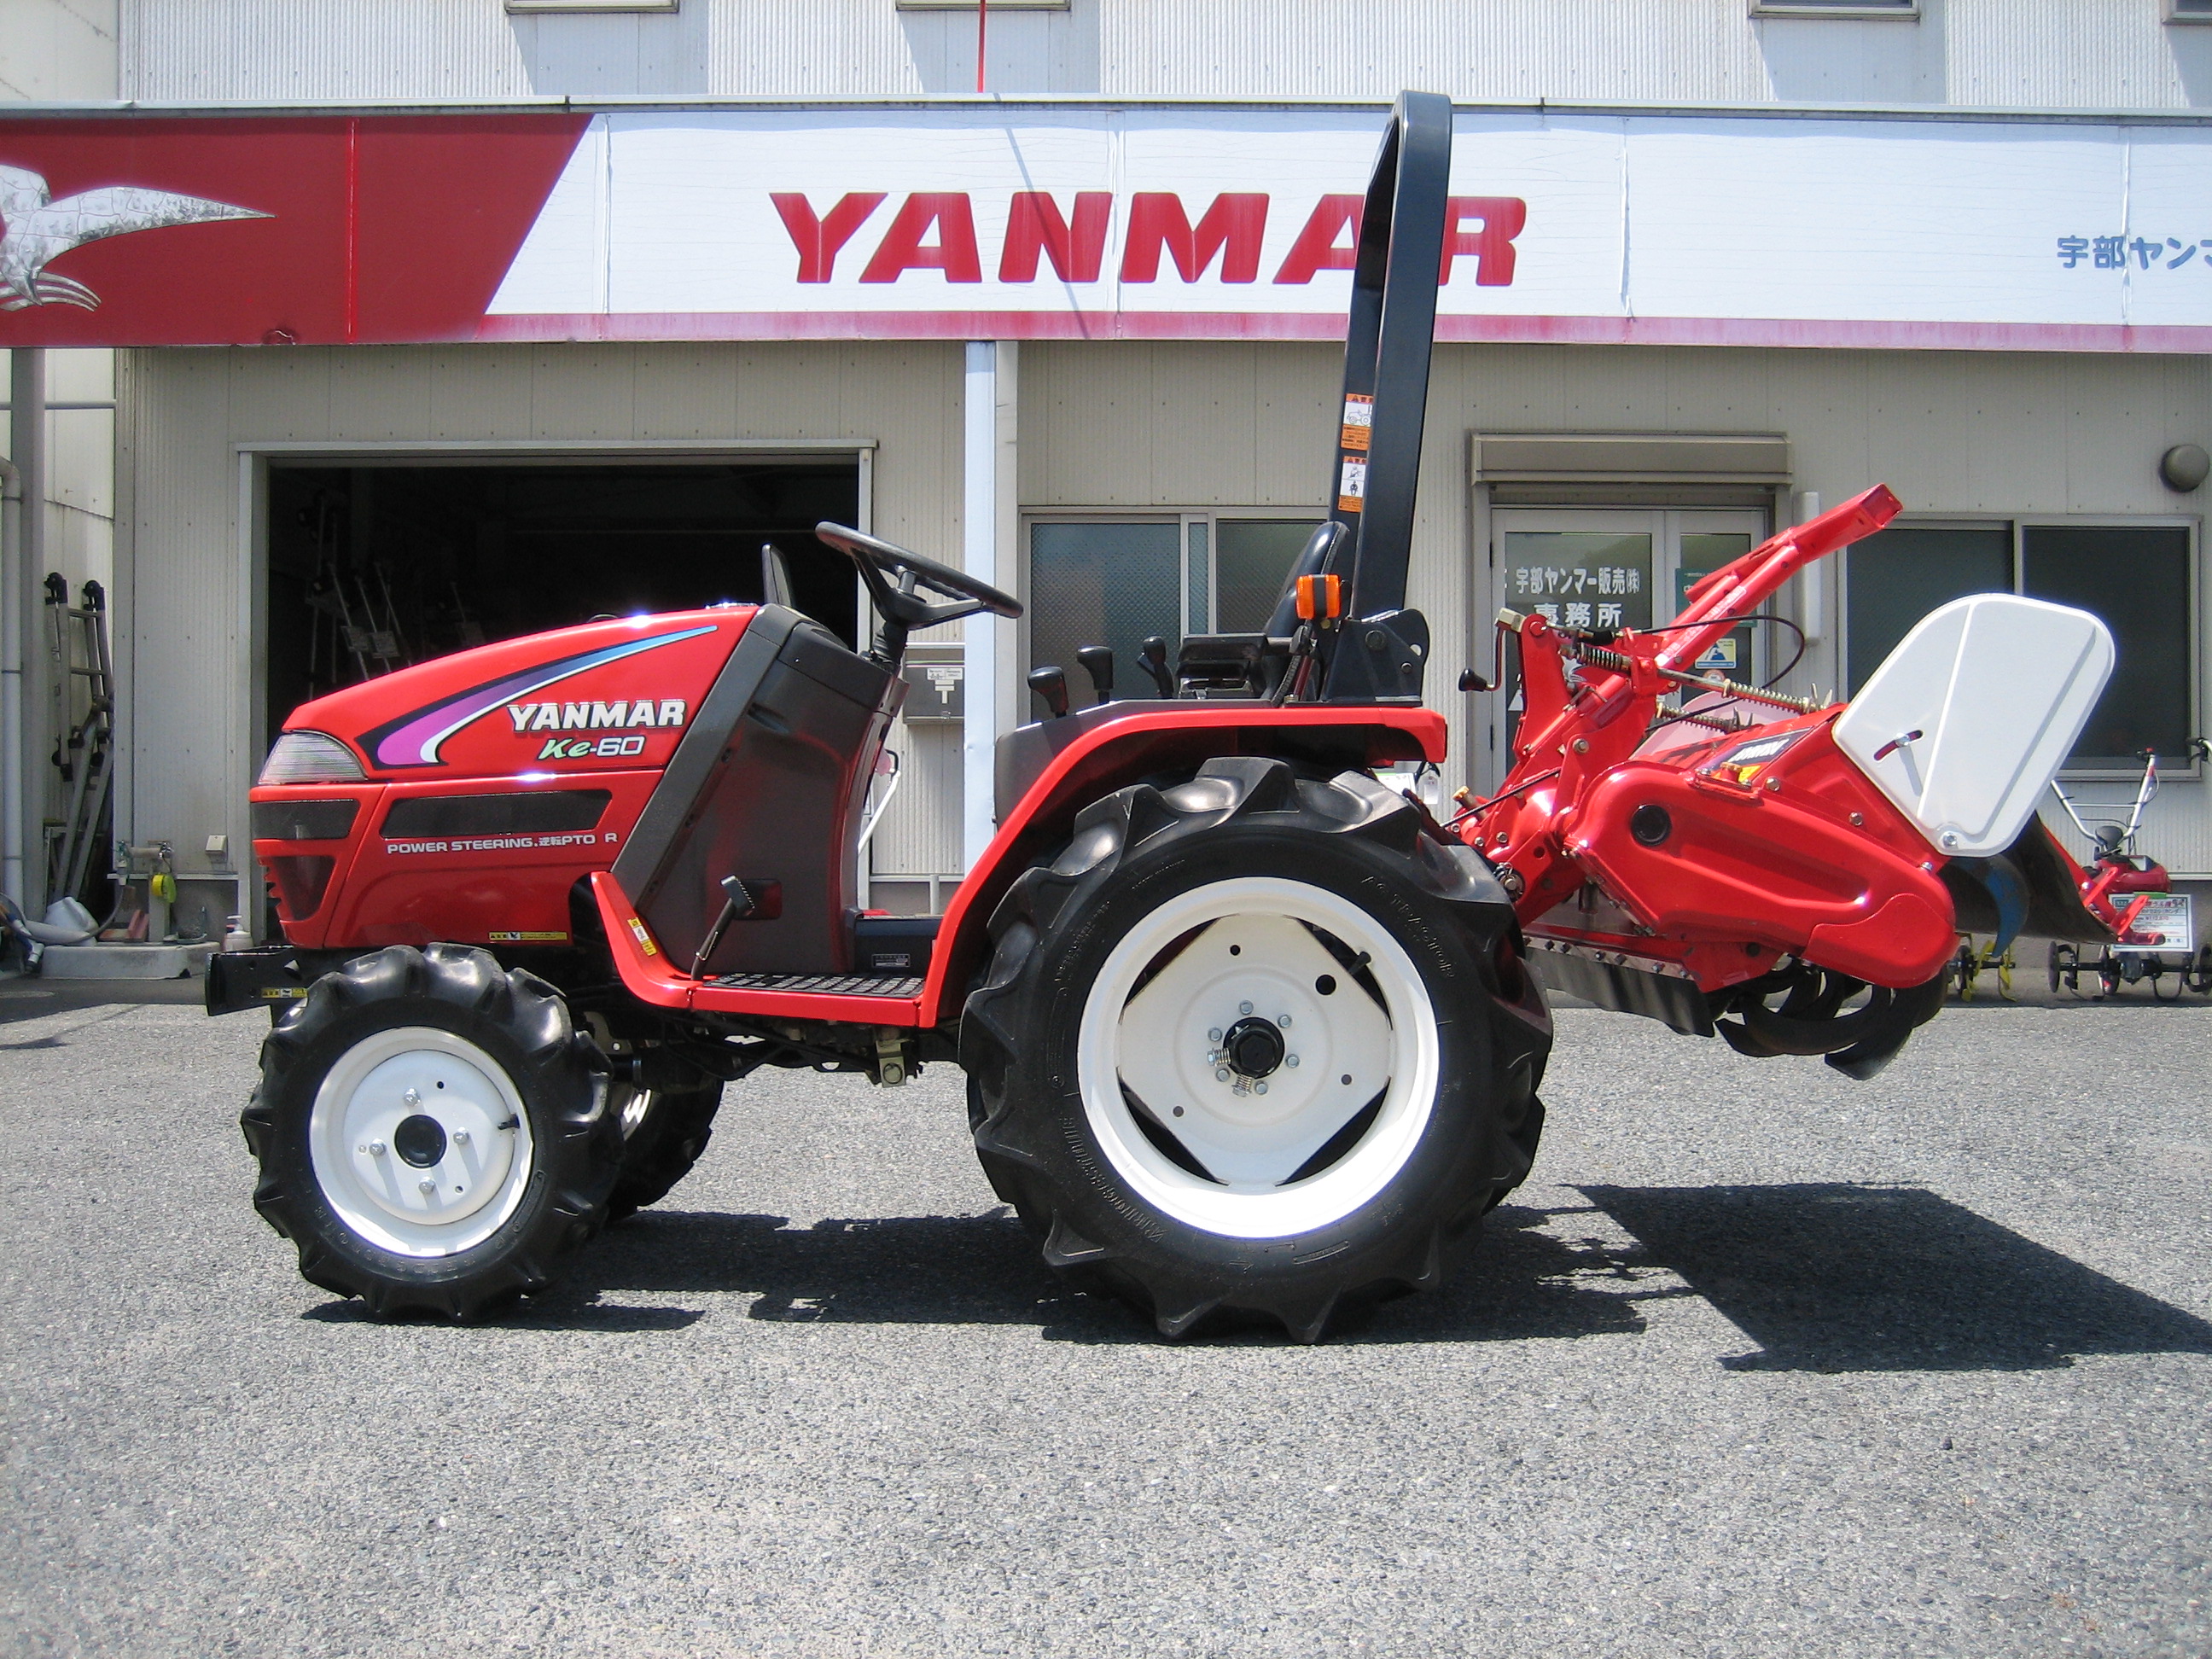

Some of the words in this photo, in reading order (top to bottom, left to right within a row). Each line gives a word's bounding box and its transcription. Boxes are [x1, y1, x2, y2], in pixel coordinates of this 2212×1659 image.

[769, 191, 1527, 286] YANMAR
[507, 699, 686, 731] YANMAR
[537, 736, 646, 760] Ke-60
[387, 841, 448, 854] POWER
[604, 832, 618, 843] R
